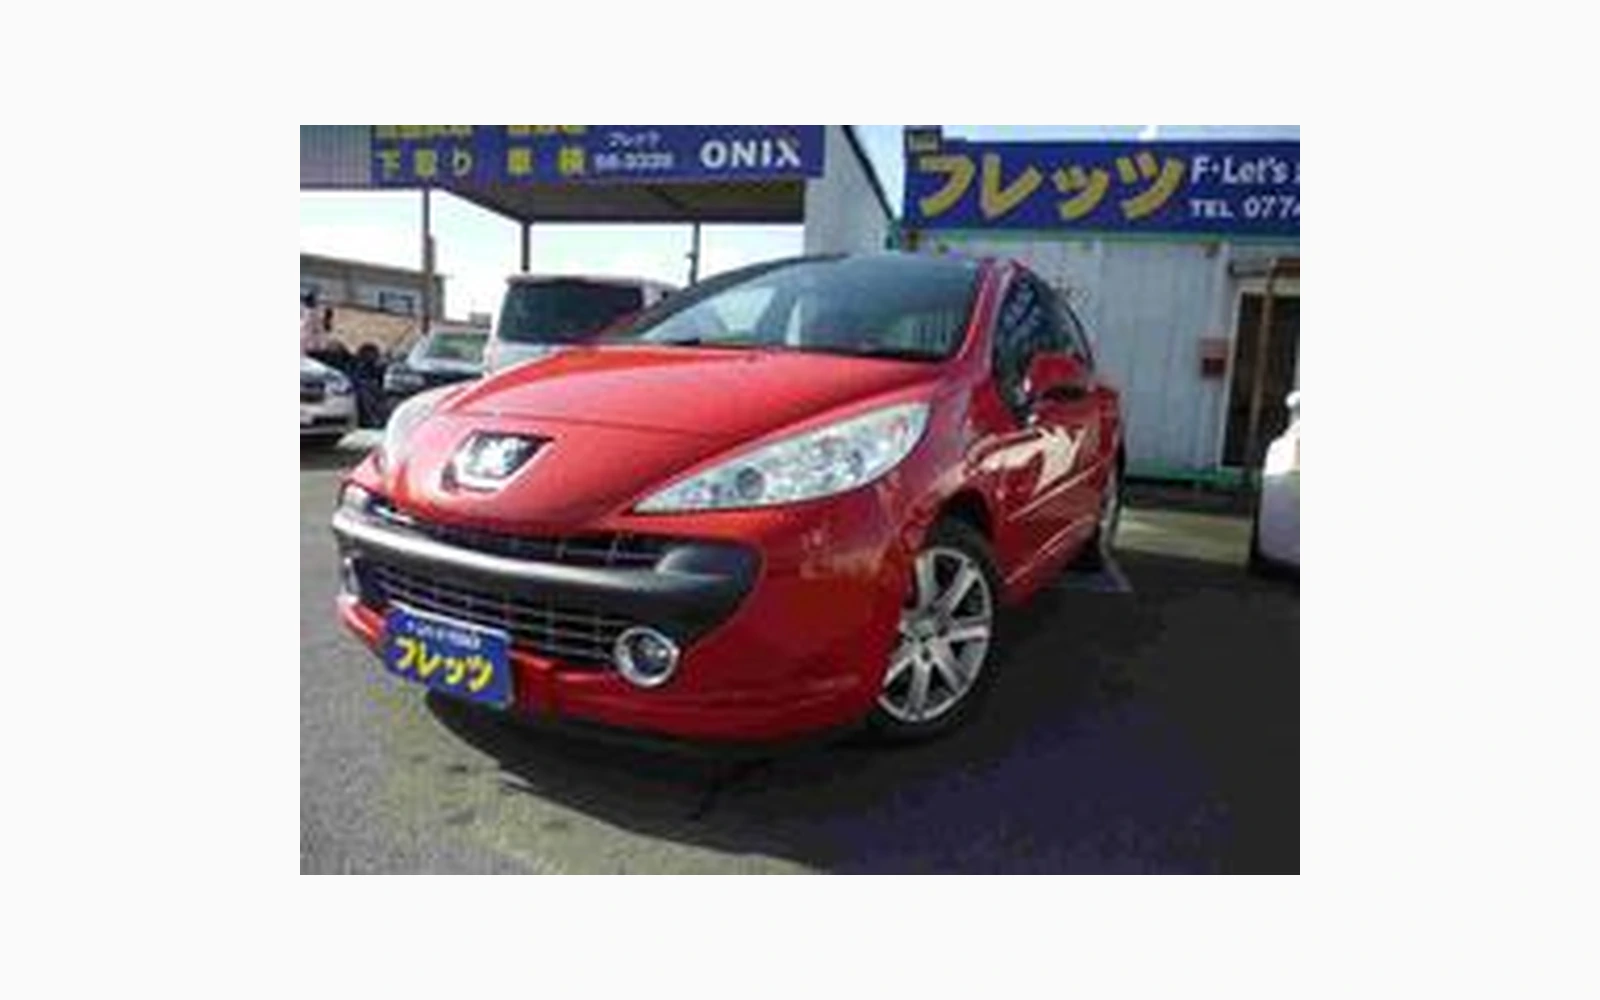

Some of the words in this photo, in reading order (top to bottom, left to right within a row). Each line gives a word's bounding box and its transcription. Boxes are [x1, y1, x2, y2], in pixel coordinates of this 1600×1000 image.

[699, 138, 802, 169] ONIX
[917, 151, 1188, 221] フレッツ
[1190, 199, 1235, 218] TEL
[395, 636, 493, 692] フレッツ
